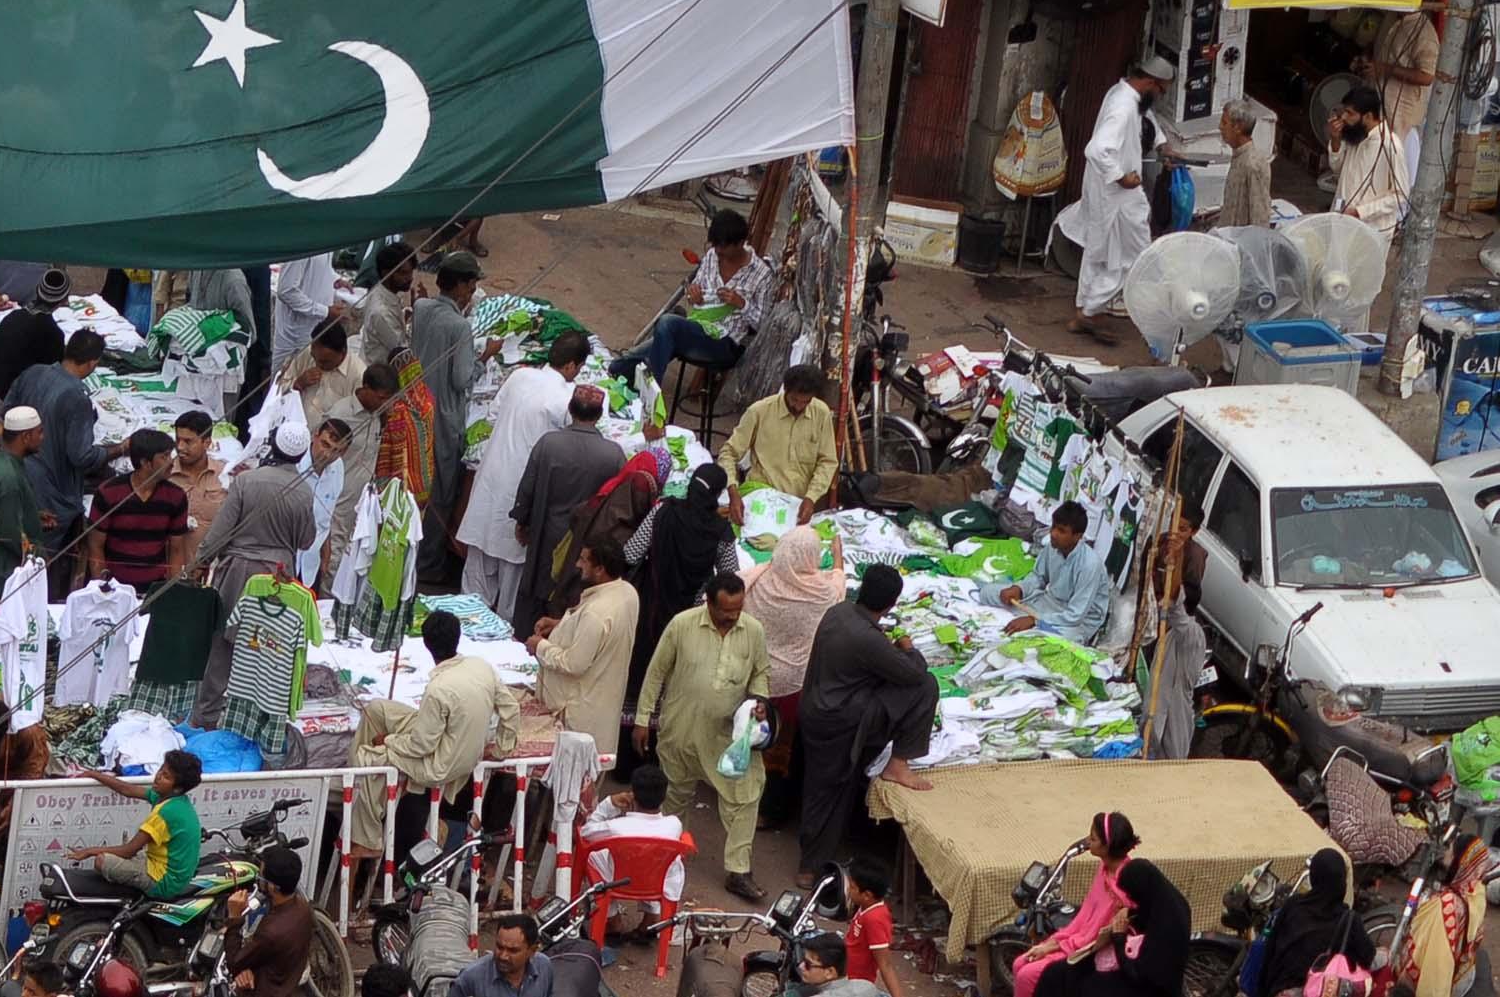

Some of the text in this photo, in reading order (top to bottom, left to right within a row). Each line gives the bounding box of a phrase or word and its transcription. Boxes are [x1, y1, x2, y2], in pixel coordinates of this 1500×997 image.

[36, 793, 77, 811] Obey
[203, 787, 219, 802] It
[221, 787, 267, 802] saves
